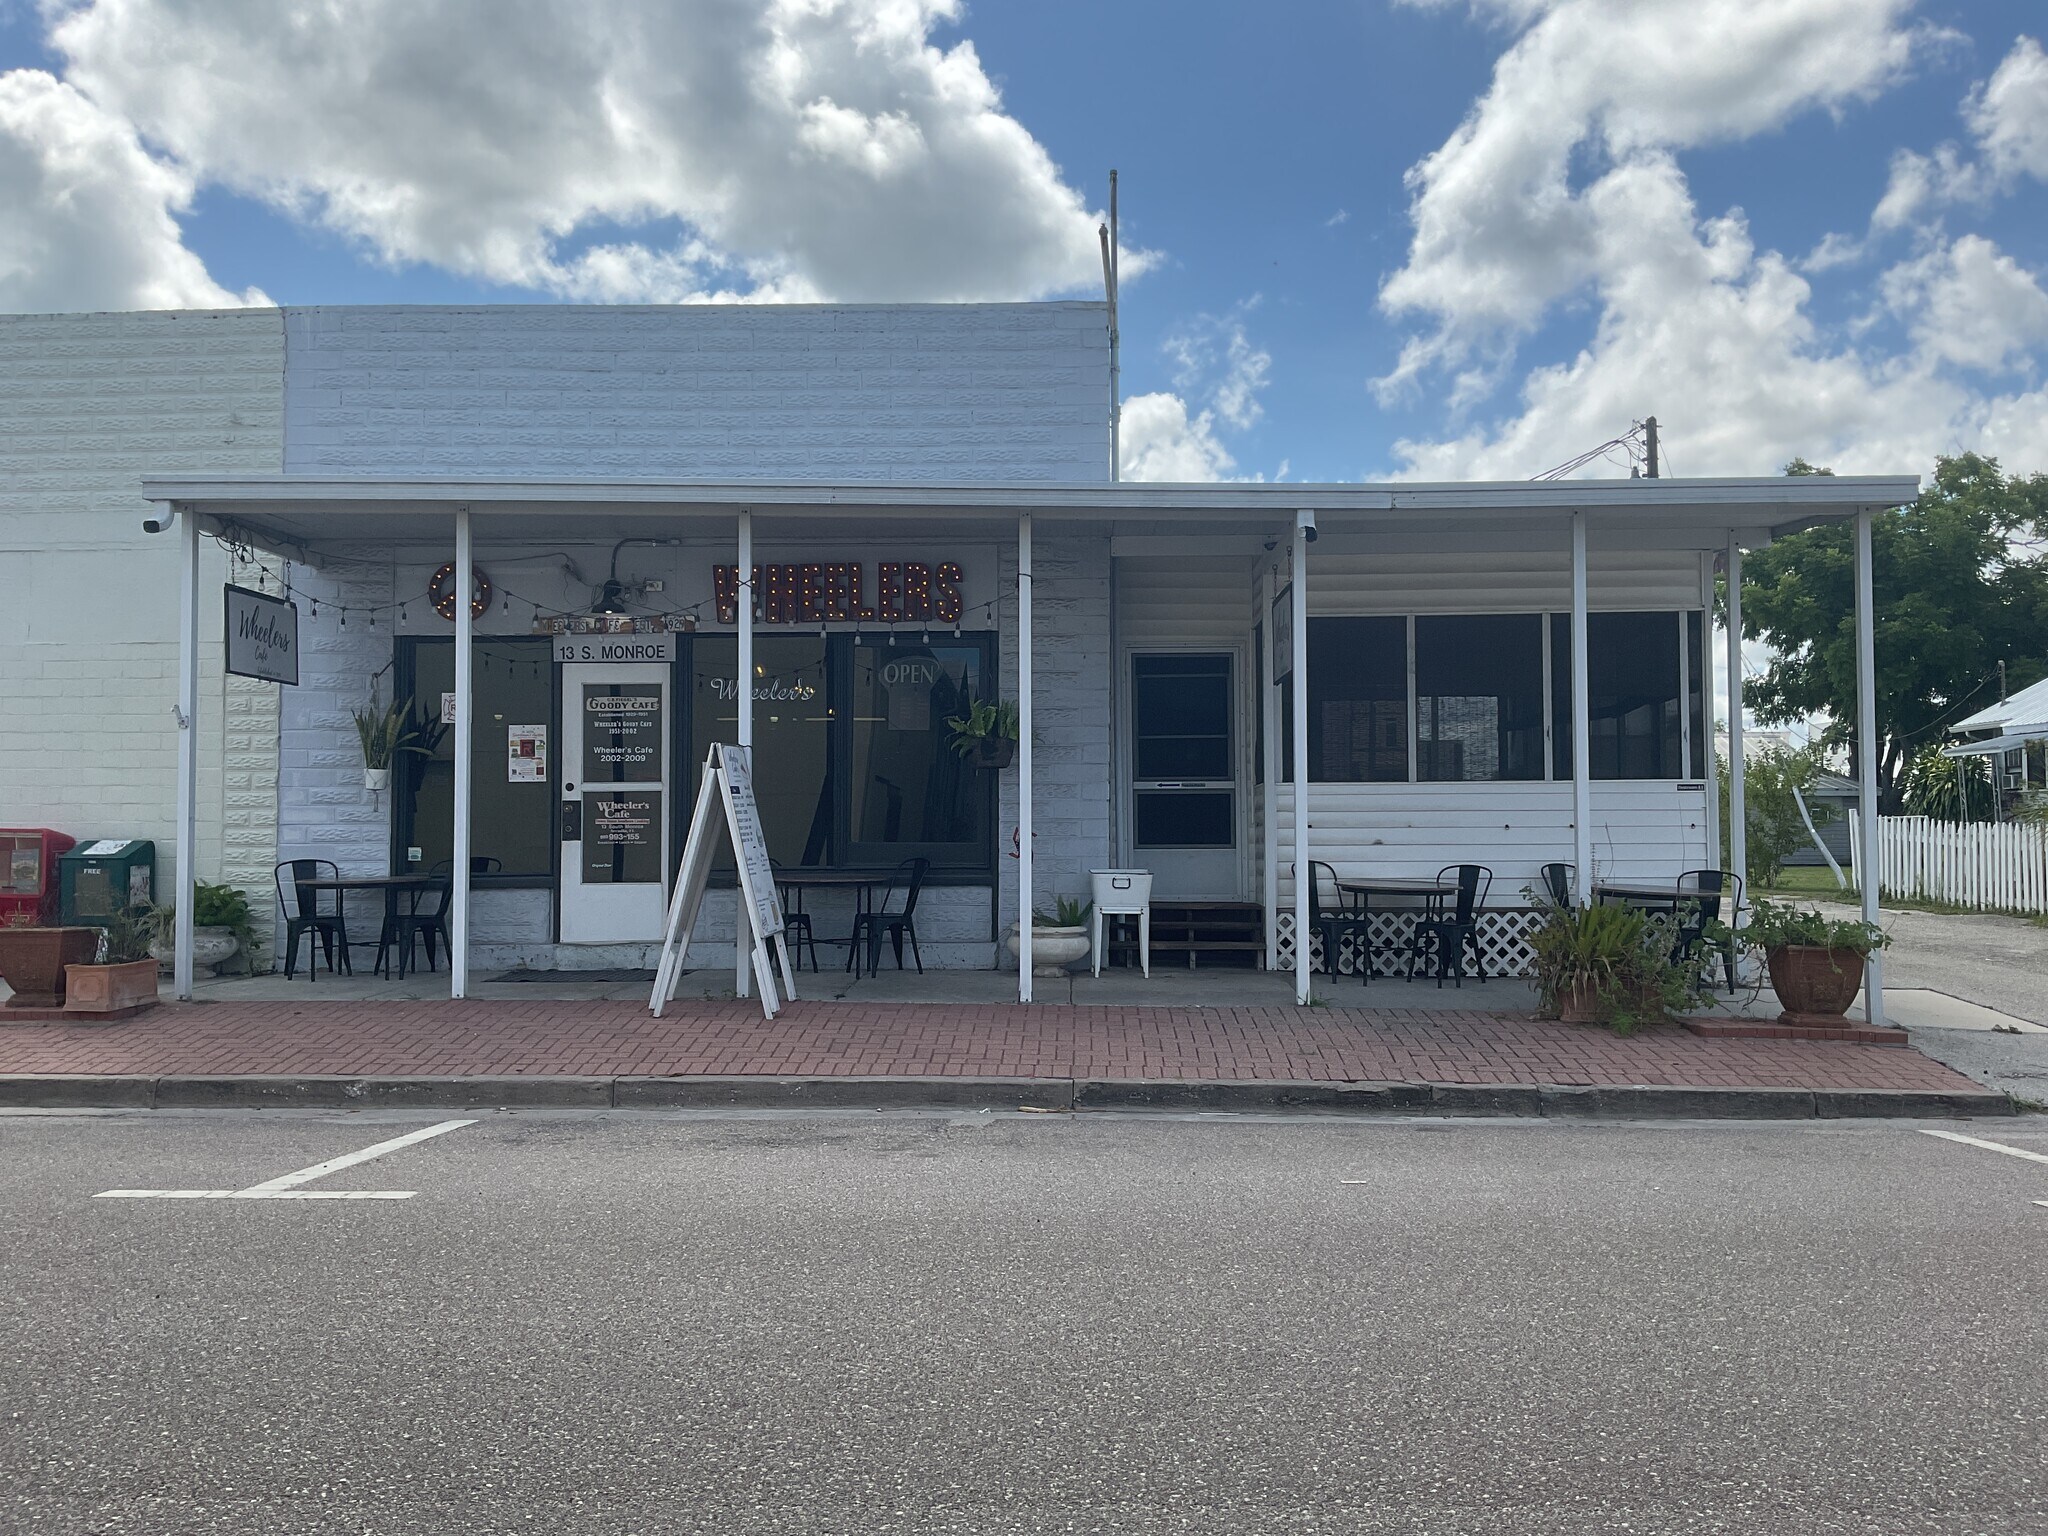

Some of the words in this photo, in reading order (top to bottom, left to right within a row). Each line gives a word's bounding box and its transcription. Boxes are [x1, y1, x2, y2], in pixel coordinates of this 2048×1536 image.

[713, 562, 964, 624] WHEELERS
[239, 605, 290, 652] Wheelers
[541, 619, 587, 632] WHEEERS
[594, 618, 620, 631] CFE
[664, 618, 684, 631] 929
[560, 646, 575, 660] 13
[581, 646, 595, 660] S.
[601, 645, 665, 659] MONROE
[883, 663, 935, 684] OPEN
[710, 678, 815, 701] Weeler's
[589, 698, 628, 710] GOODY
[631, 701, 657, 710] CAFE
[593, 746, 632, 754] Wheeler's
[634, 746, 653, 754] Cafe
[600, 754, 646, 762] 2002-2009
[596, 801, 650, 811] Wheeler's
[604, 809, 630, 818] Cafe
